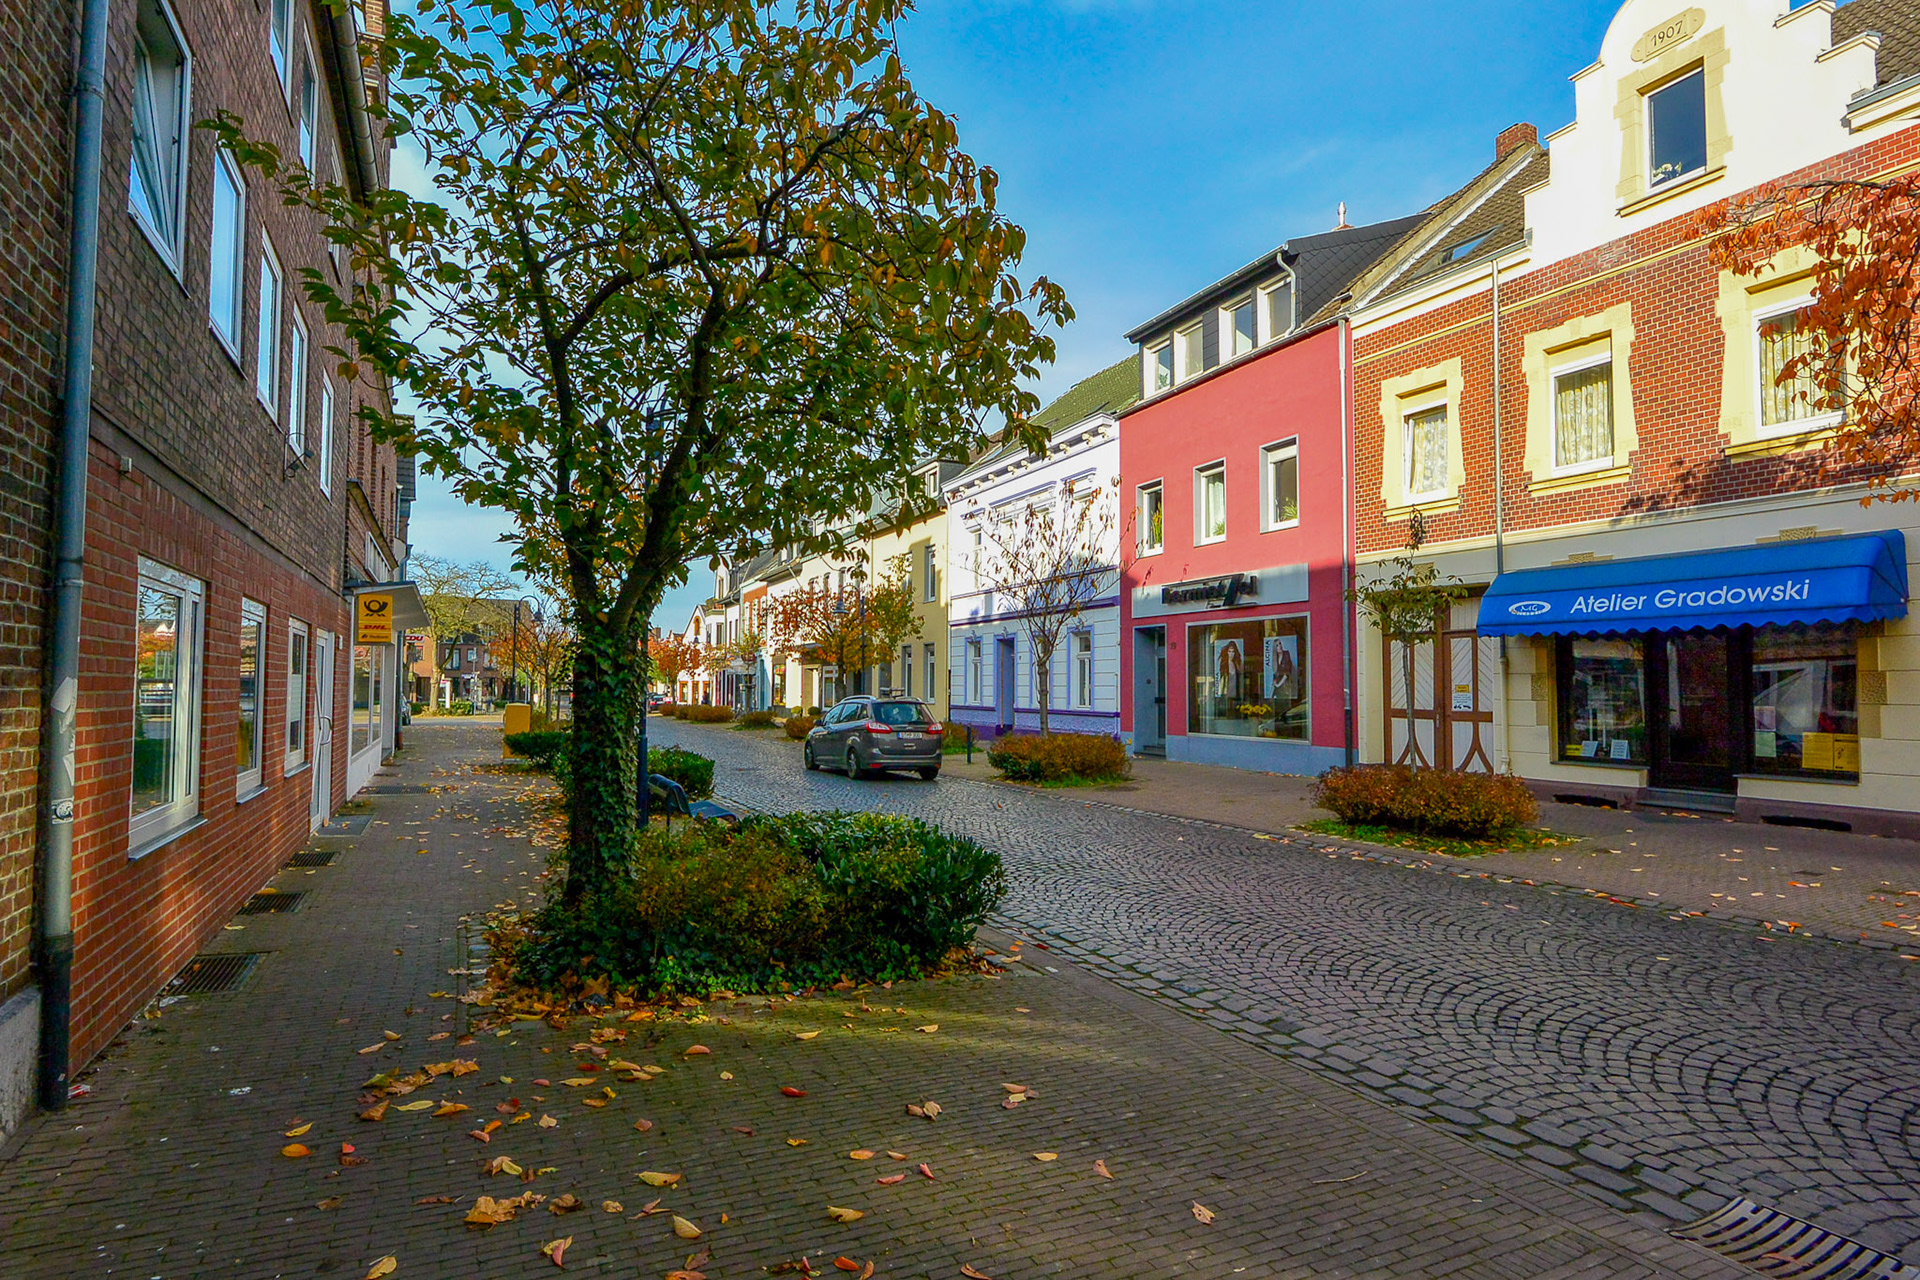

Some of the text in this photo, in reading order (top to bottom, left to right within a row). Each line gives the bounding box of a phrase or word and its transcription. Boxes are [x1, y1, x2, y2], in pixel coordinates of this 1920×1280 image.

[1651, 20, 1683, 46] 1907
[1570, 579, 1810, 614] Atelier Gradowski
